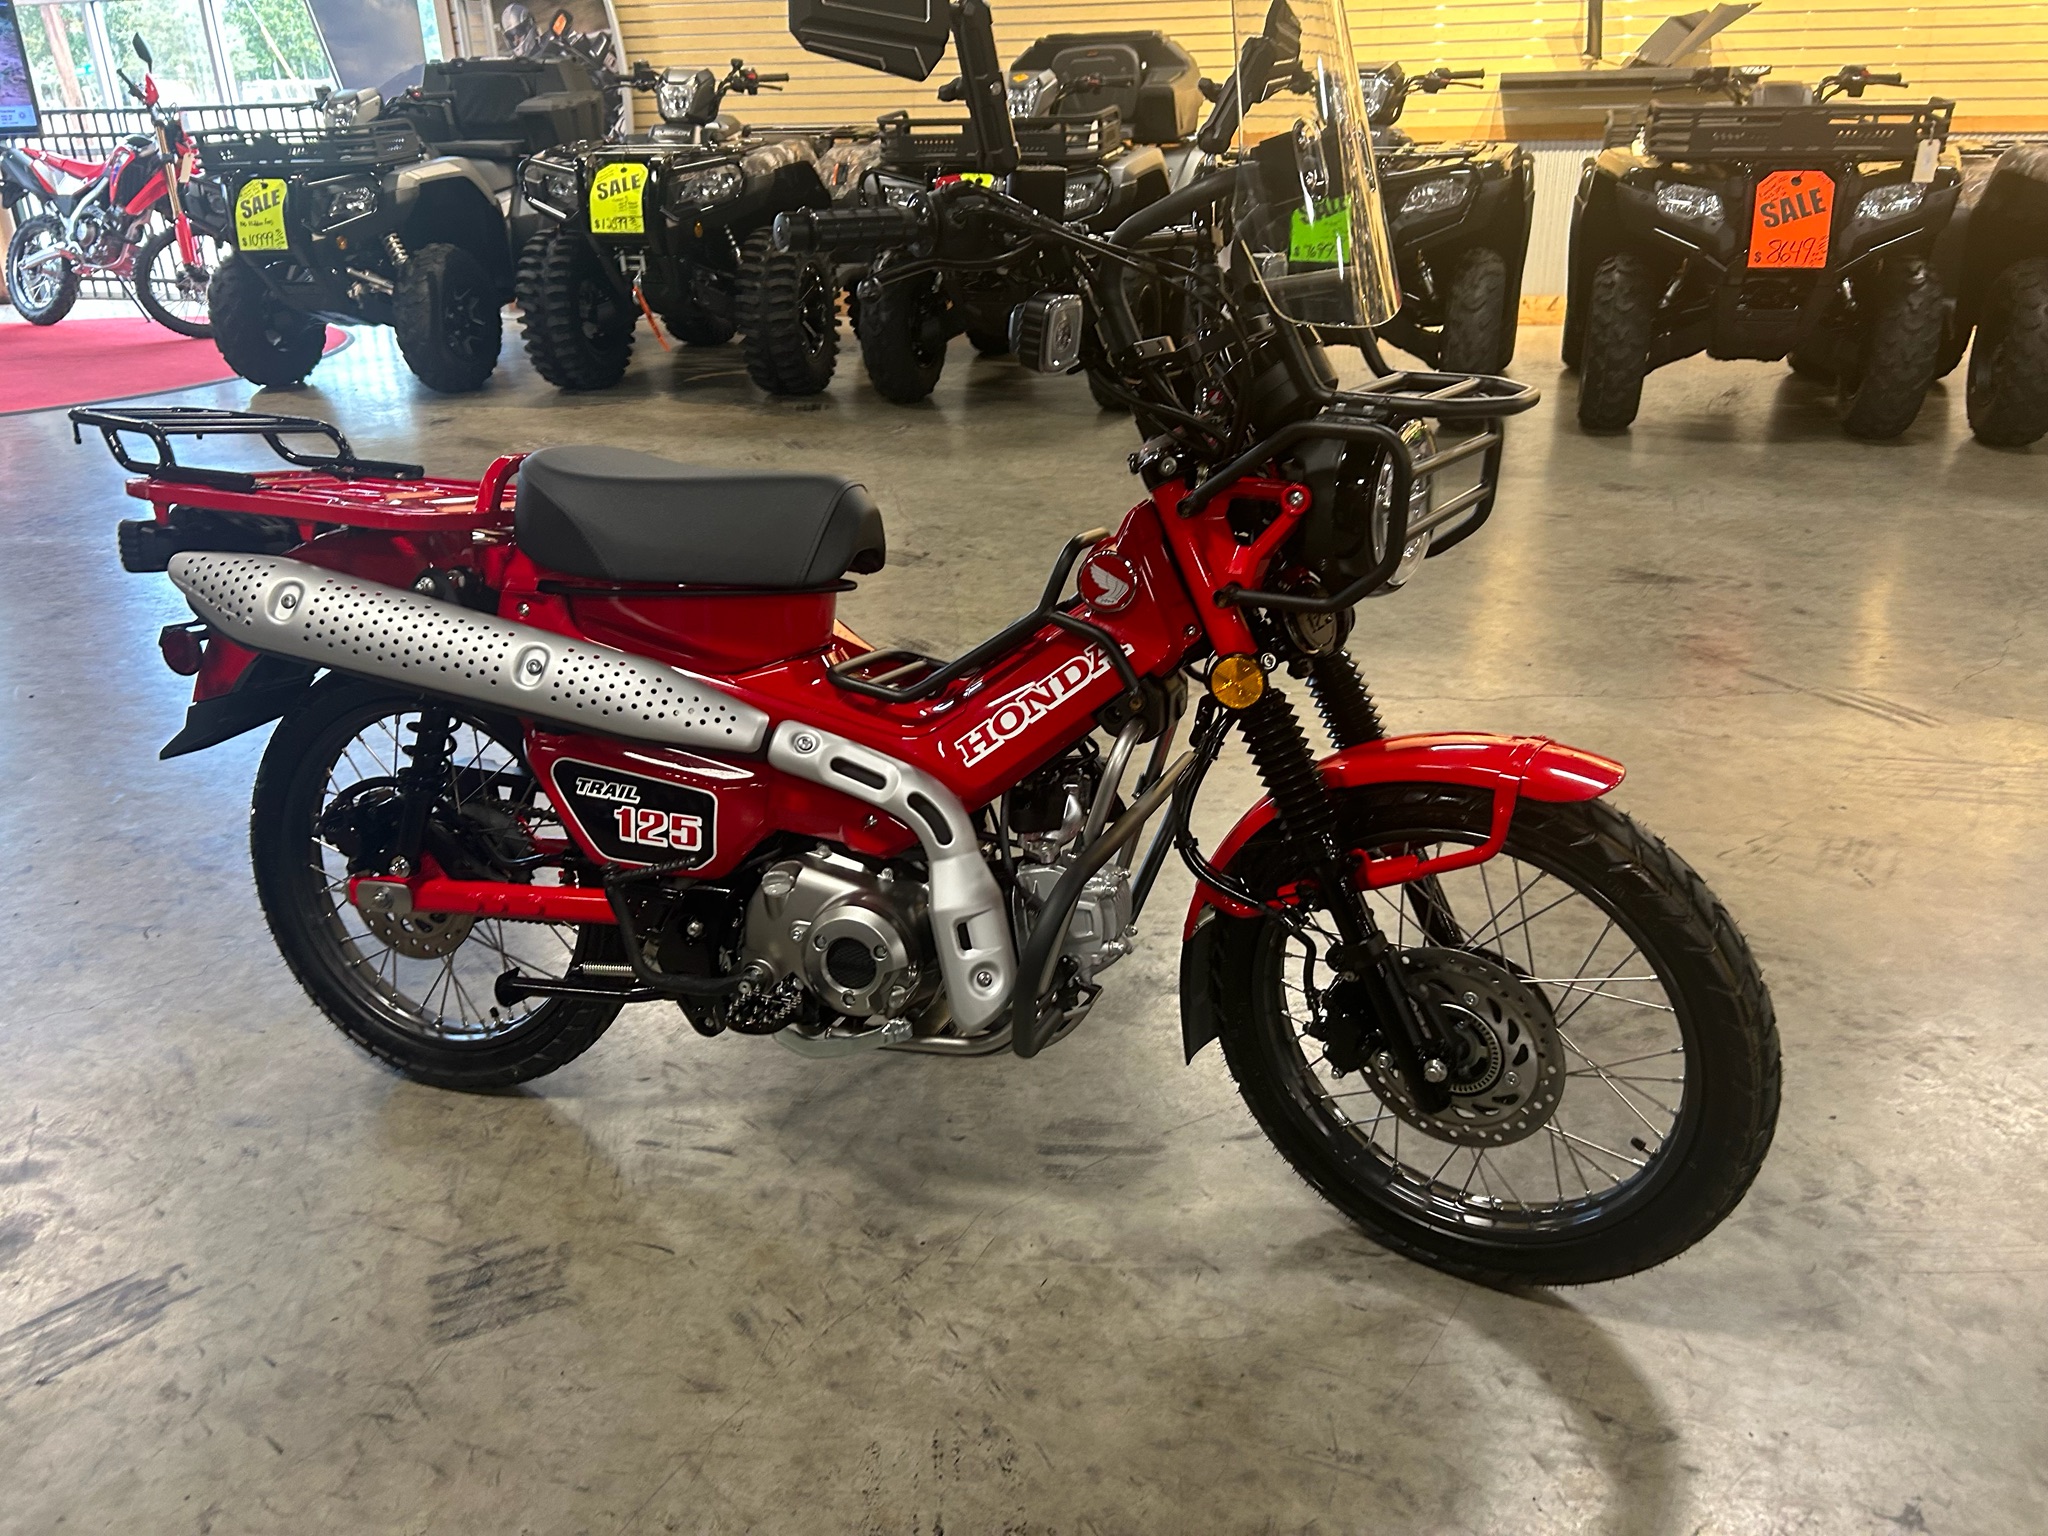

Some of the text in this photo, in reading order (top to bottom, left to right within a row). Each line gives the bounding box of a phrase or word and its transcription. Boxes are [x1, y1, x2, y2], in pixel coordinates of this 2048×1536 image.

[240, 189, 281, 219] SALE
[596, 173, 641, 201] SALE
[1760, 187, 1827, 228] SALE
[953, 641, 1135, 768] HONDA
[575, 777, 641, 805] TRAIL
[613, 805, 703, 852] 125
